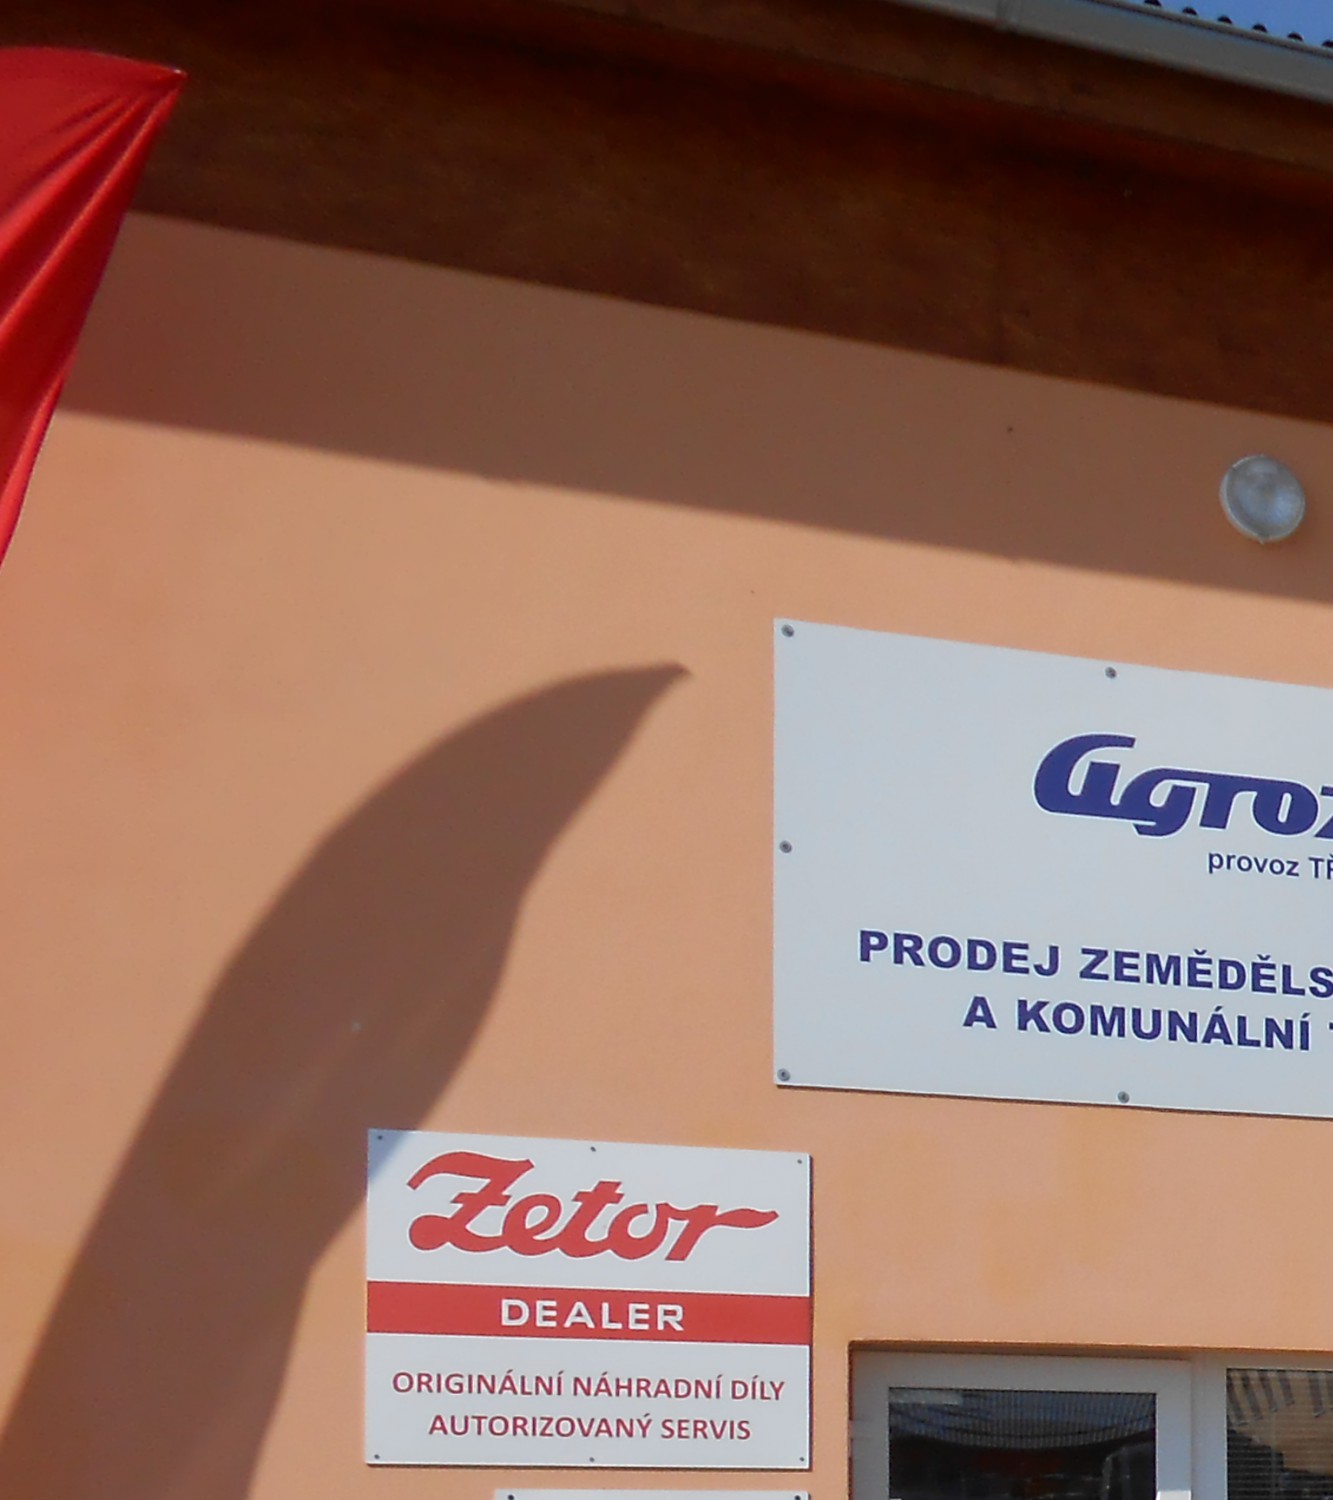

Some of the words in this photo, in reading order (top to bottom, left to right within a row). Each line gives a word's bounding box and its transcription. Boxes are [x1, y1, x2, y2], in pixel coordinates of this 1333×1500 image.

[1208, 852, 1300, 877] provoz
[859, 929, 1060, 977] PRODEJ
[963, 995, 998, 1030] A
[1017, 998, 1311, 1053] KOMUNÁLNÍ
[407, 1150, 779, 1262] Zetor
[501, 1298, 685, 1331] DEALER
[392, 1369, 563, 1397] ORIGINÁLNÍ
[573, 1371, 722, 1400] NÁHRADNÍ
[731, 1375, 785, 1401] DÍLY
[428, 1412, 653, 1439] AUTORIZOVANÝ
[661, 1418, 751, 1440] SERVIS
